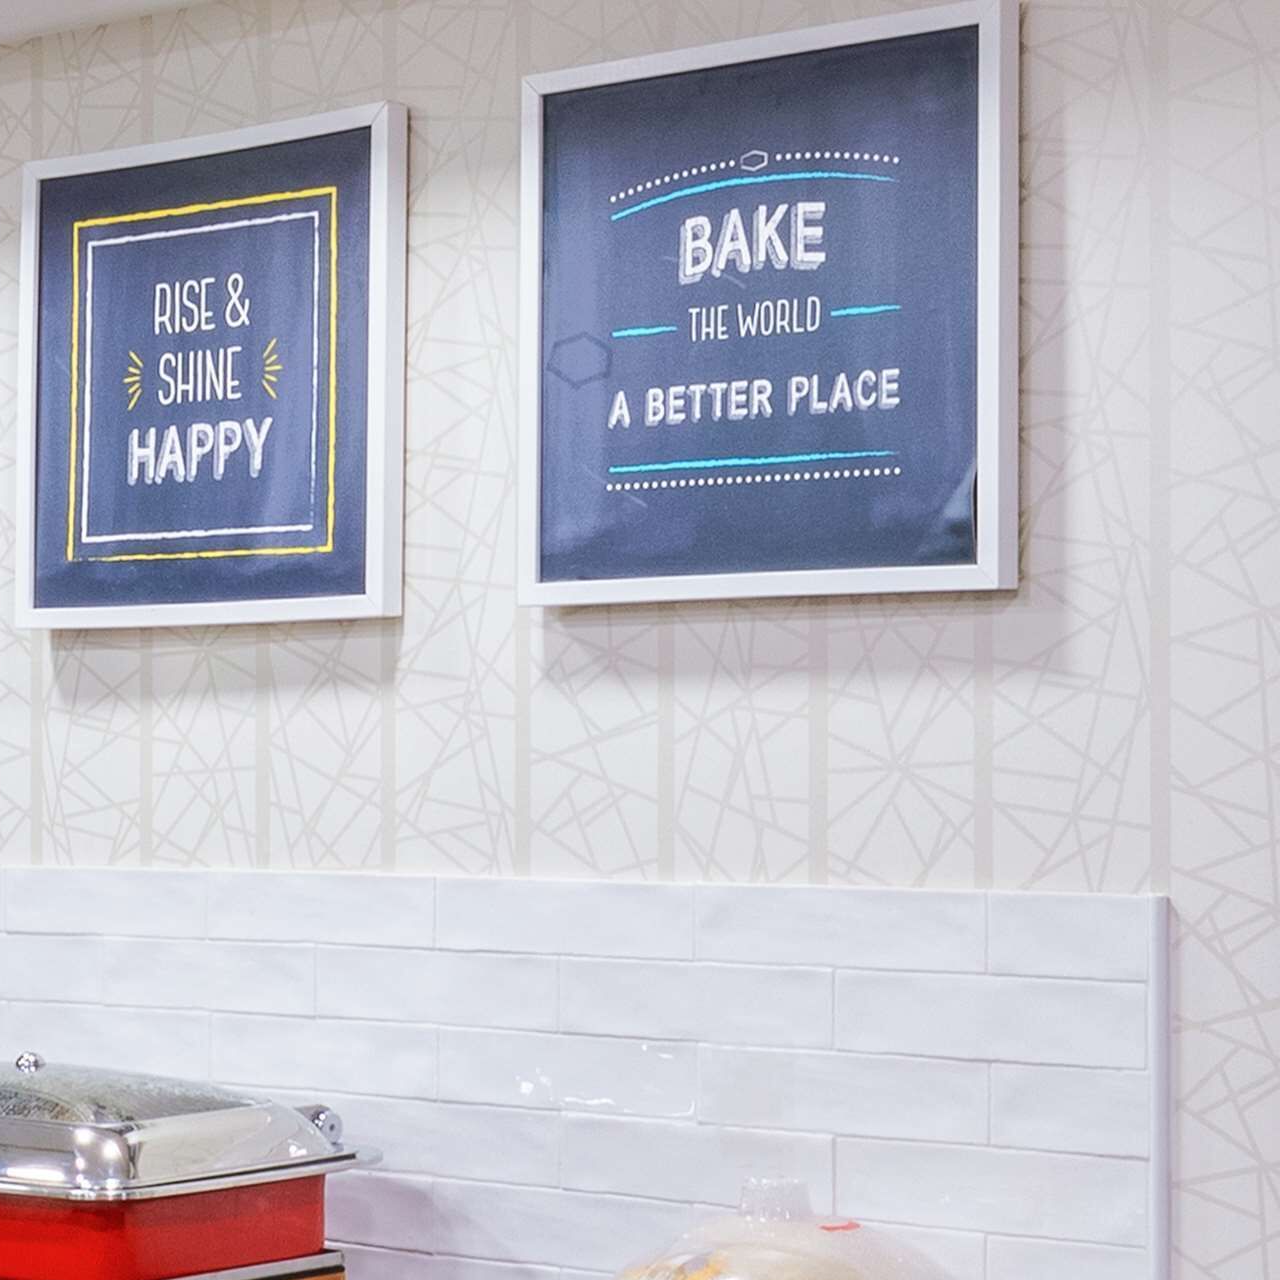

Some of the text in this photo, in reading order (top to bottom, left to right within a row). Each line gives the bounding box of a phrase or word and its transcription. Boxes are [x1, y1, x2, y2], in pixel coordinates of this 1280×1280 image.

[680, 203, 827, 286] BAKE
[156, 274, 250, 335] RISE &
[689, 297, 821, 342] THE WORLD
[160, 347, 243, 406] SHINE
[609, 369, 901, 430] A BETTER PLACE
[129, 418, 274, 486] HAPPY
